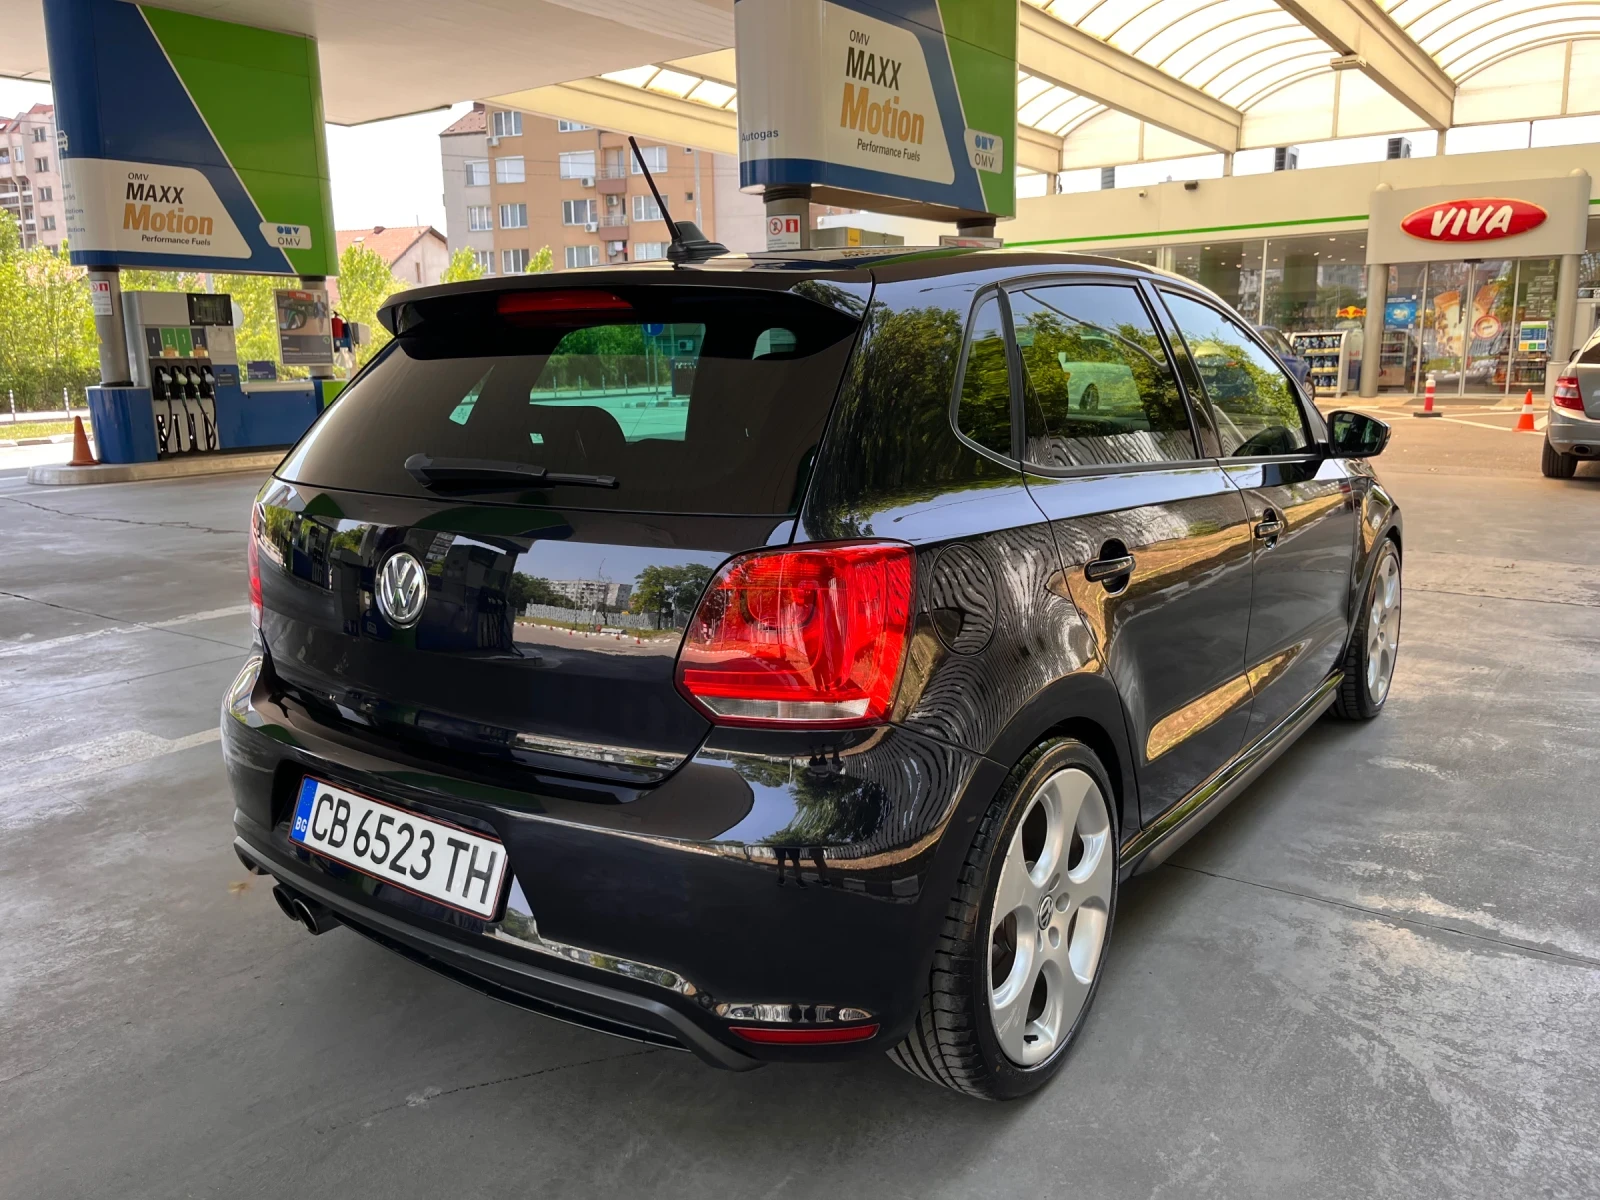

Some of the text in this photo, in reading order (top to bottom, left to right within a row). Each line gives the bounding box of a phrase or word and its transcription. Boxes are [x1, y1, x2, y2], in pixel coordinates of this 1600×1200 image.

[849, 29, 870, 46] OMV
[845, 46, 902, 91] MAXX
[840, 82, 925, 145] Motion
[741, 129, 779, 142] Autogas
[856, 138, 921, 162] Performance Fuels
[974, 152, 995, 168] OMV
[127, 172, 149, 181] OMV
[126, 182, 184, 204] MAXX
[123, 203, 213, 235] Motion
[1429, 204, 1513, 237] VIVA
[141, 234, 211, 246] Performance Fuels
[277, 236, 300, 246] OMV
[294, 816, 308, 833] BG
[311, 793, 498, 905] CB 6523 TH
